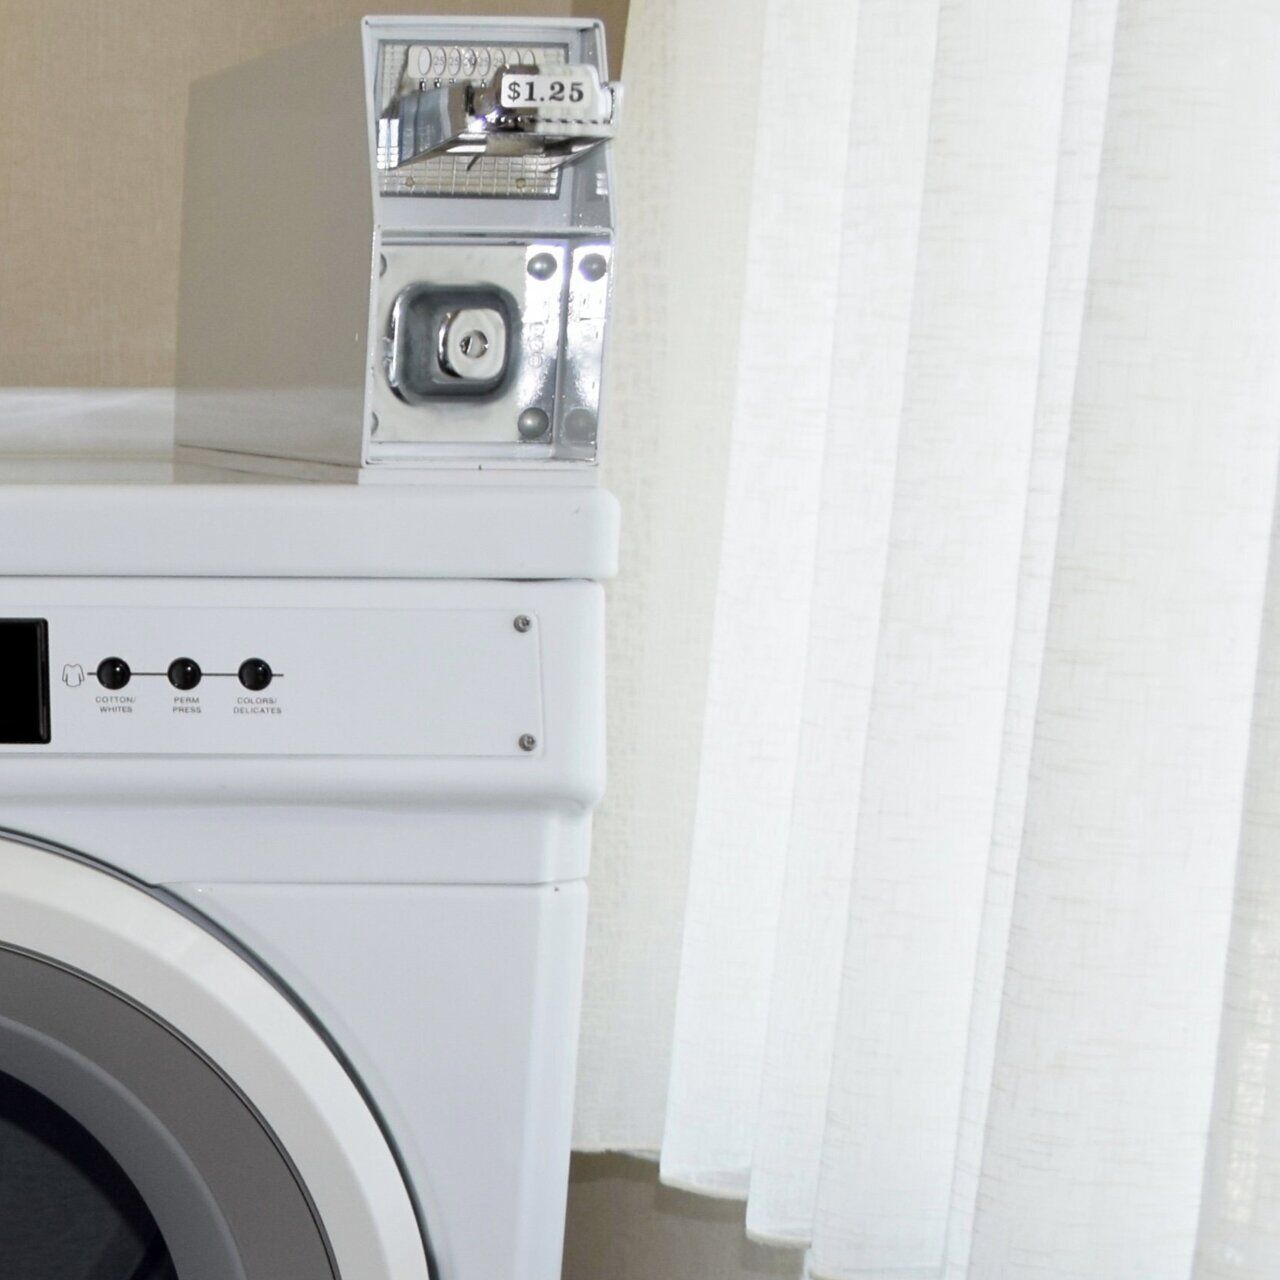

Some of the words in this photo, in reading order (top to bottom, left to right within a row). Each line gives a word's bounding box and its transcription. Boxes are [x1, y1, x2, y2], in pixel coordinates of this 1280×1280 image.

[507, 80, 585, 103] $1.25
[173, 696, 200, 704] PERM
[99, 705, 133, 714] WHITES
[172, 706, 202, 714] PRESS
[233, 706, 282, 715] DELICATES
